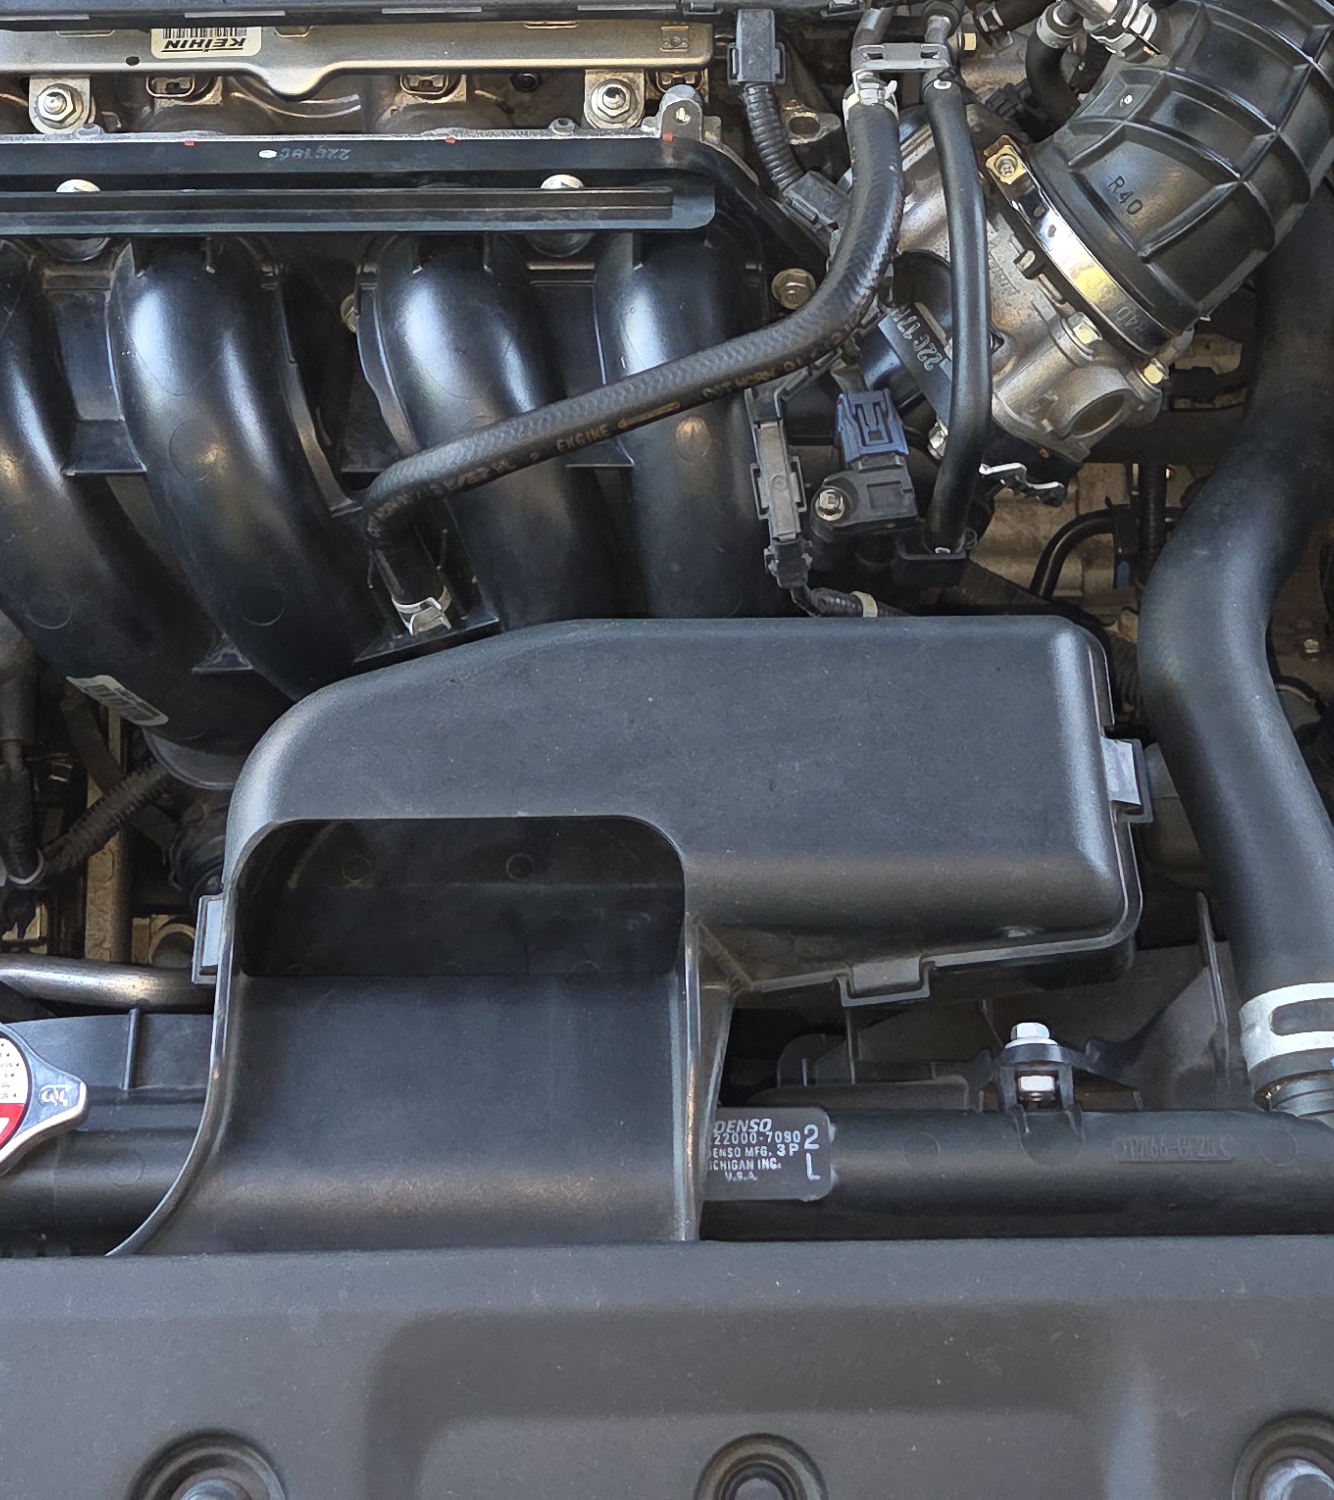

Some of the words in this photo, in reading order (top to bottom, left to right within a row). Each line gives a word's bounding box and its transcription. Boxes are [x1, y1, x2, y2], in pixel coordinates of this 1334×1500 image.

[164, 37, 246, 52] KEIHIN
[1107, 175, 1144, 215] R40
[713, 1118, 772, 1133] DENSO
[804, 1124, 820, 1150] 2
[708, 1159, 754, 1171] ICHIGAN
[805, 1152, 821, 1181] L
